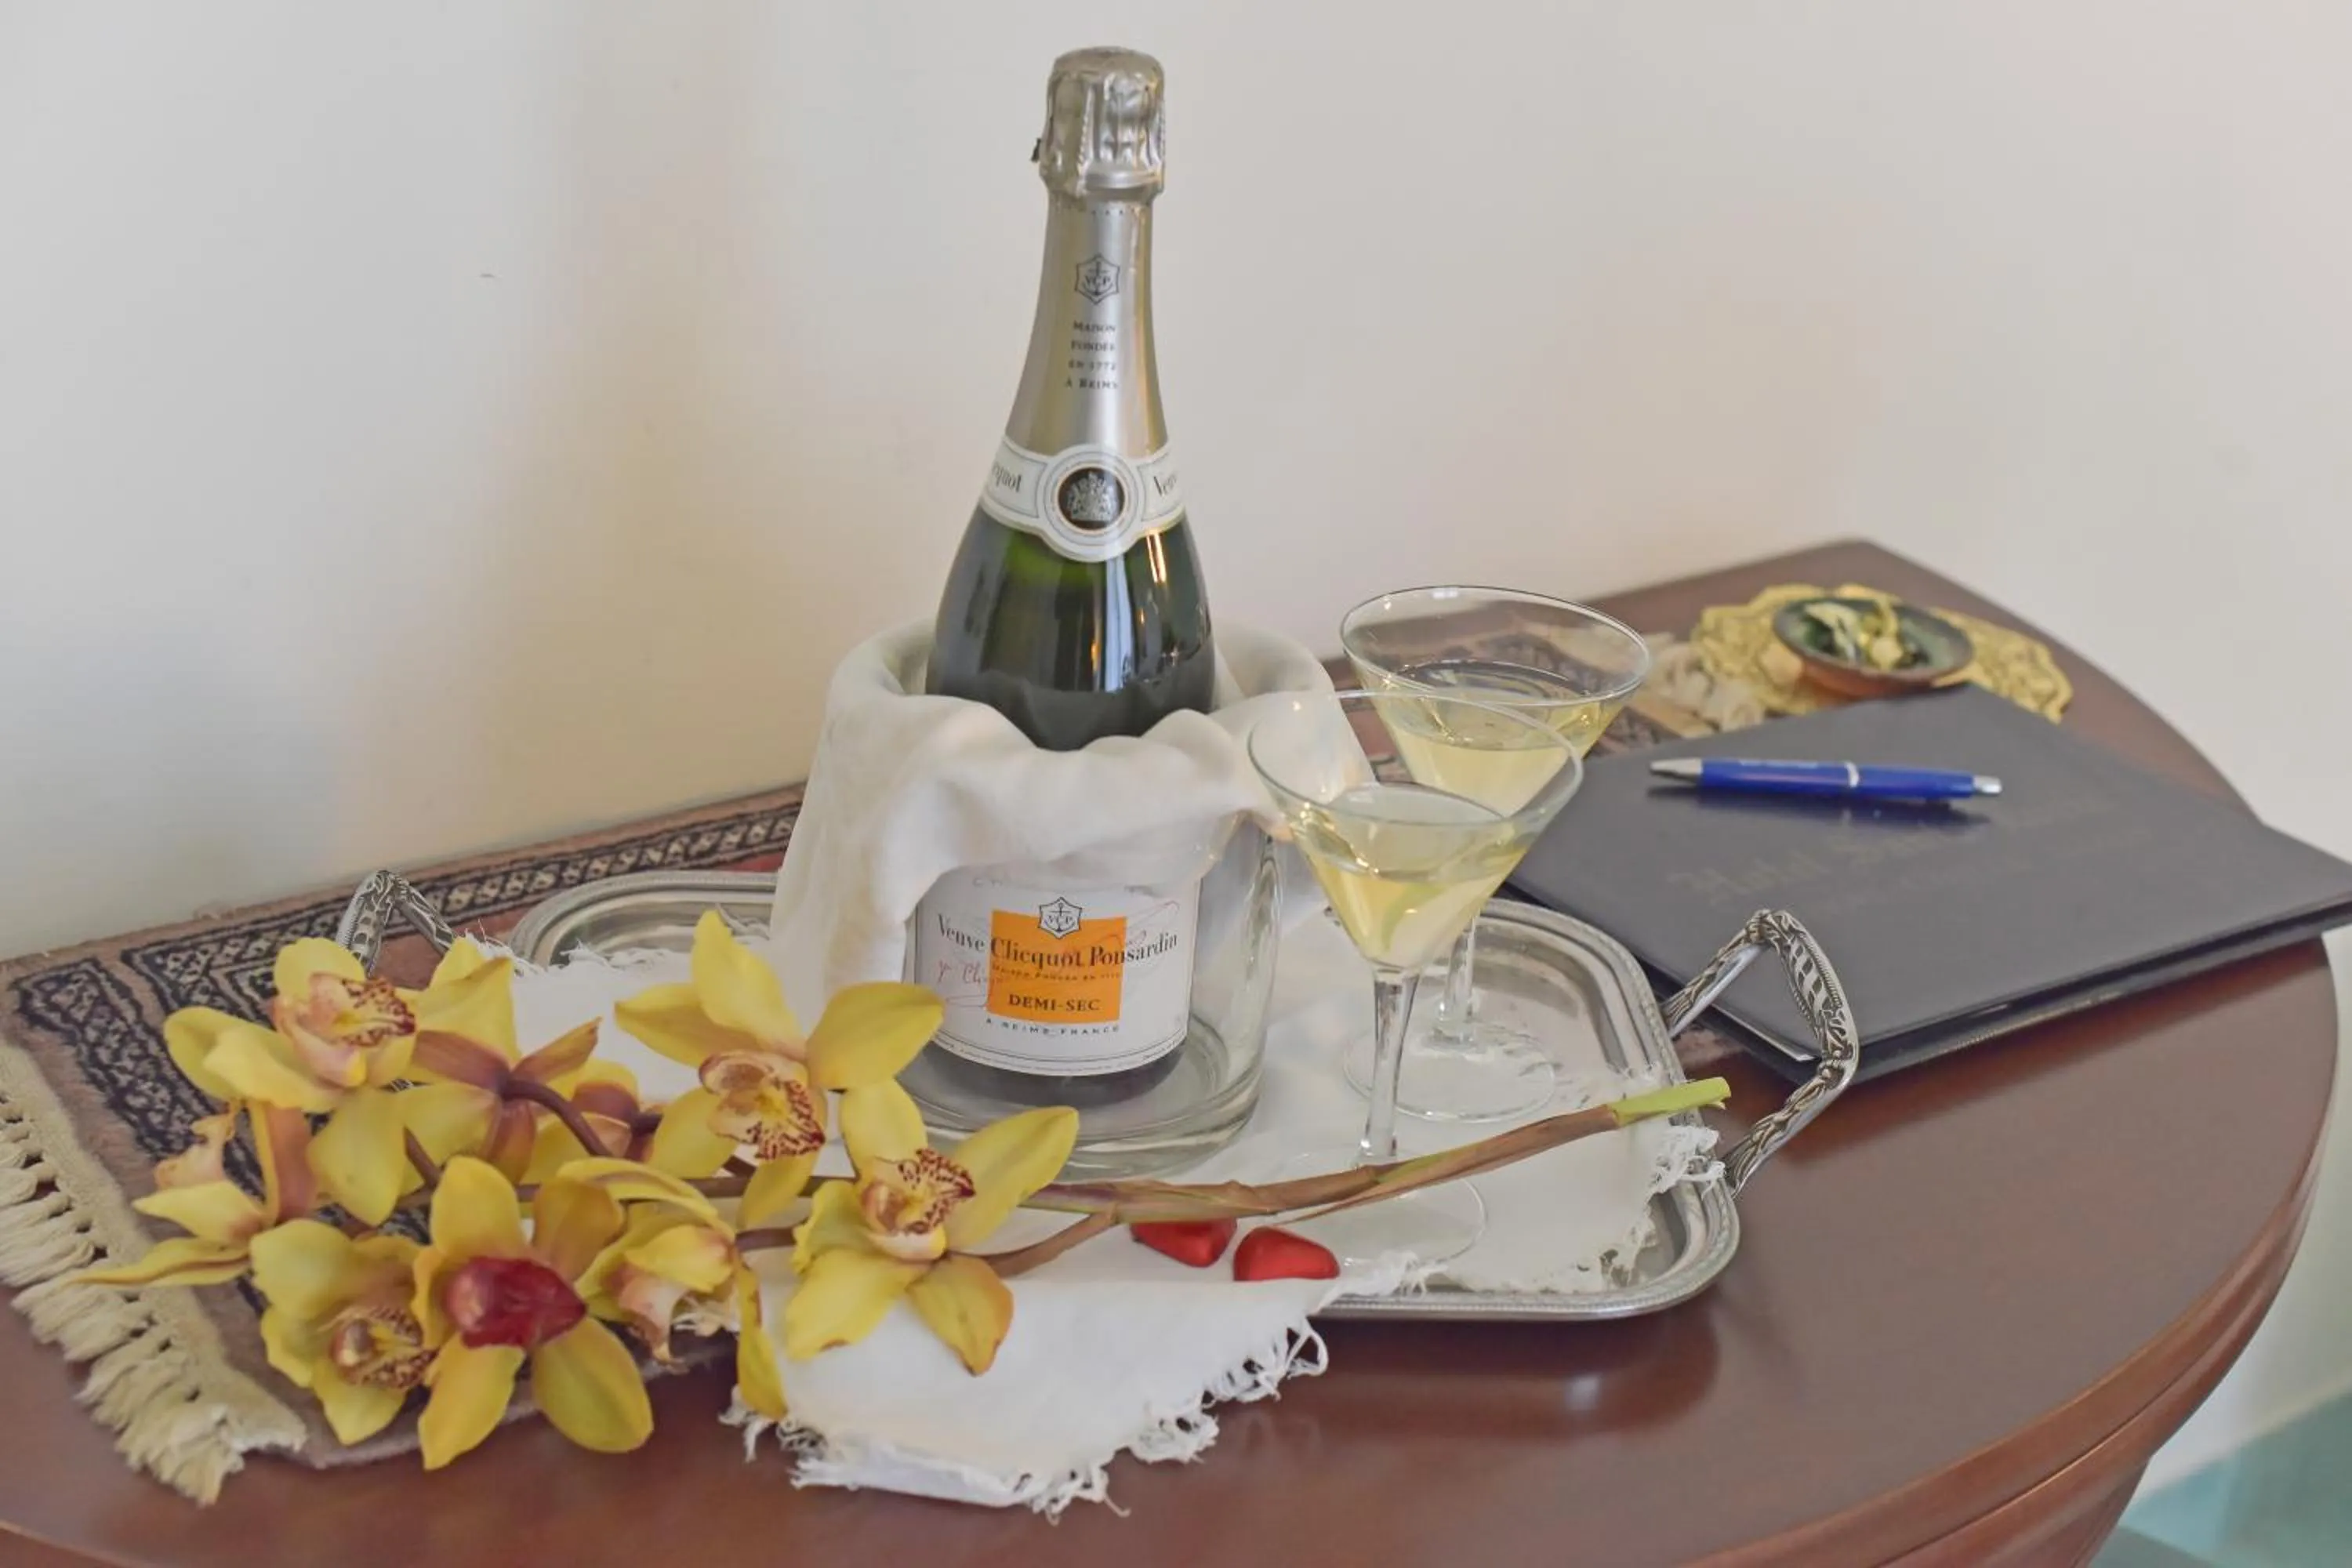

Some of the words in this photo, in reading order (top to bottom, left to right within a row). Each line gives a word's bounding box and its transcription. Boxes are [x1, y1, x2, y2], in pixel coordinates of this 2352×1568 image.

[938, 913, 985, 953] Veuve
[990, 936, 1085, 971] Clicquot
[1091, 931, 1178, 967] Ponsardin
[1008, 993, 1102, 1012] DEMI-SEC
